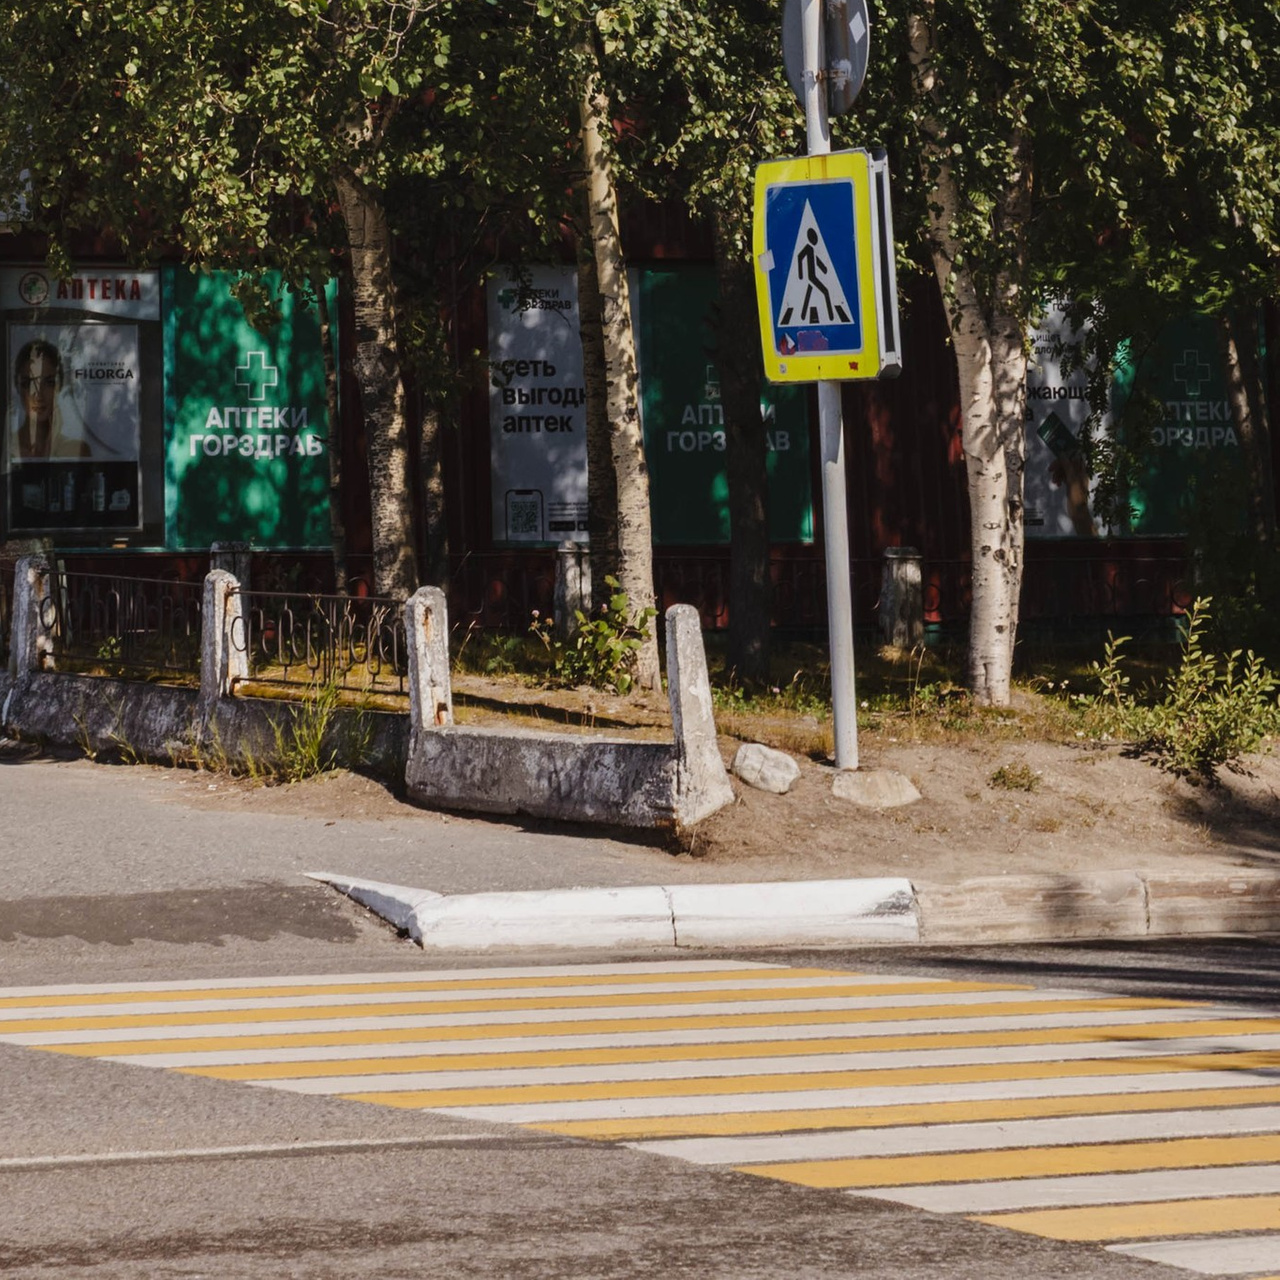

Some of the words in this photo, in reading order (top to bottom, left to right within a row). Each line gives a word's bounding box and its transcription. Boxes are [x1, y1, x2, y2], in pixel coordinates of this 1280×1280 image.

[56, 278, 142, 300] АПТЕКА
[75, 368, 134, 380] FILORGA
[501, 359, 557, 377] сеть
[205, 406, 308, 429] АПТЕКИ
[502, 415, 573, 433] аптек
[189, 434, 323, 459] ГОРЗДРАВ
